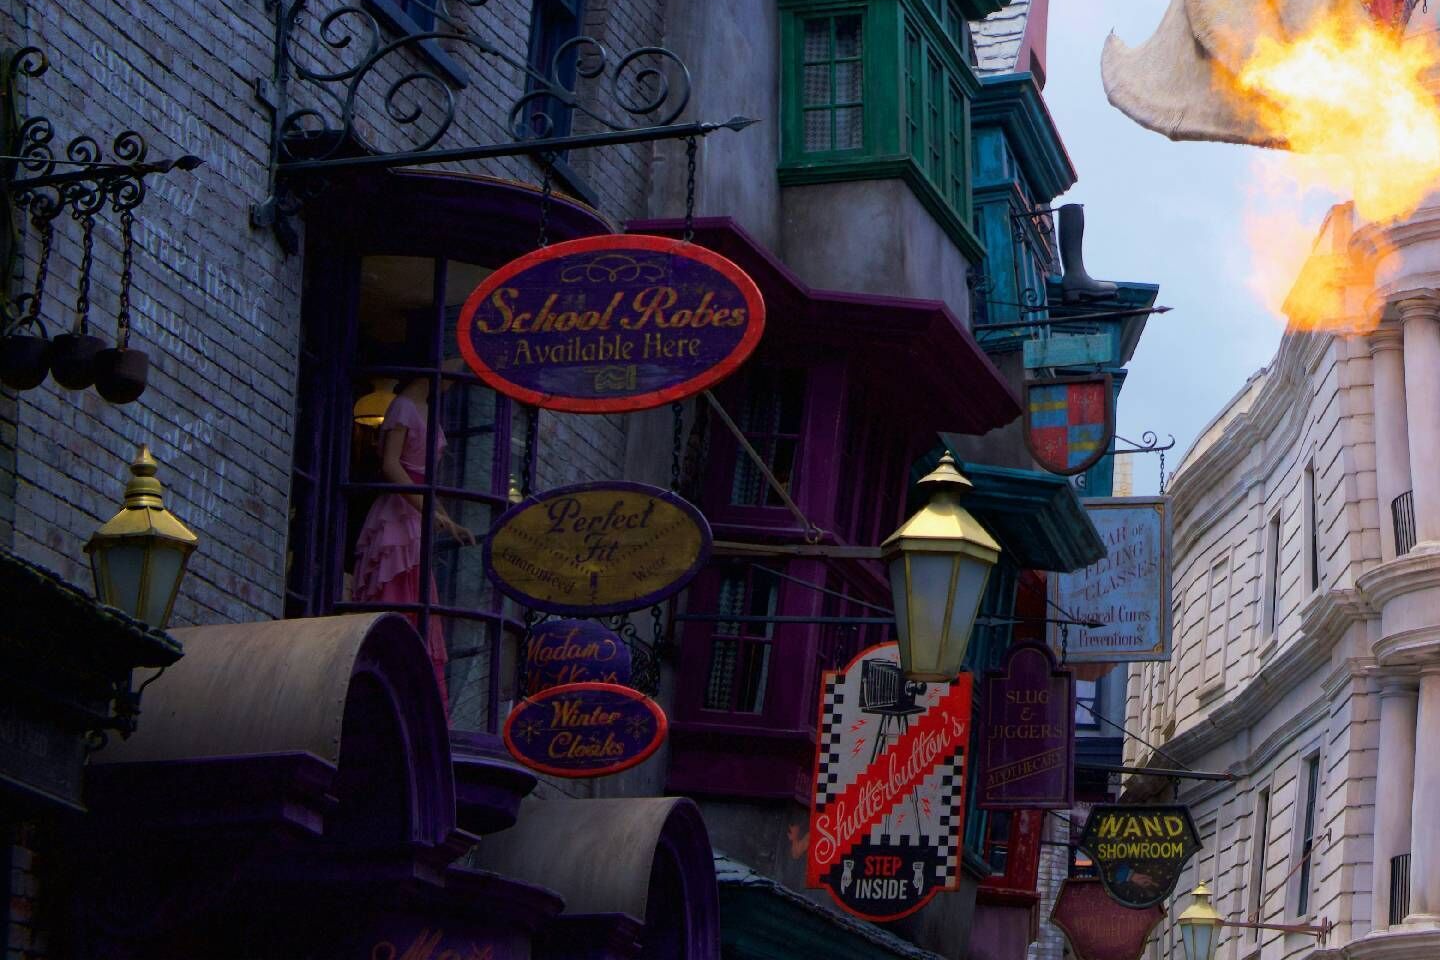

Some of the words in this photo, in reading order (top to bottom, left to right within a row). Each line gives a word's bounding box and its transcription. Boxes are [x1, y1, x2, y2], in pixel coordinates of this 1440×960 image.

[477, 287, 624, 334] School
[621, 286, 746, 331] Robes
[512, 335, 633, 366] Available
[645, 333, 702, 360] Here
[546, 497, 655, 534] Perfect
[575, 532, 619, 563] Fit
[1118, 604, 1152, 623] Cures
[1006, 690, 1050, 705] SLUG
[551, 699, 623, 729] Winter
[988, 724, 1065, 739] JIGGERS
[547, 731, 624, 759] Cloaks
[814, 710, 965, 865] Shutterbutton's
[1098, 813, 1184, 838] WAND
[1098, 842, 1183, 860] SHOWROOM
[863, 855, 902, 877] STEP
[855, 878, 908, 900] INSIDE
